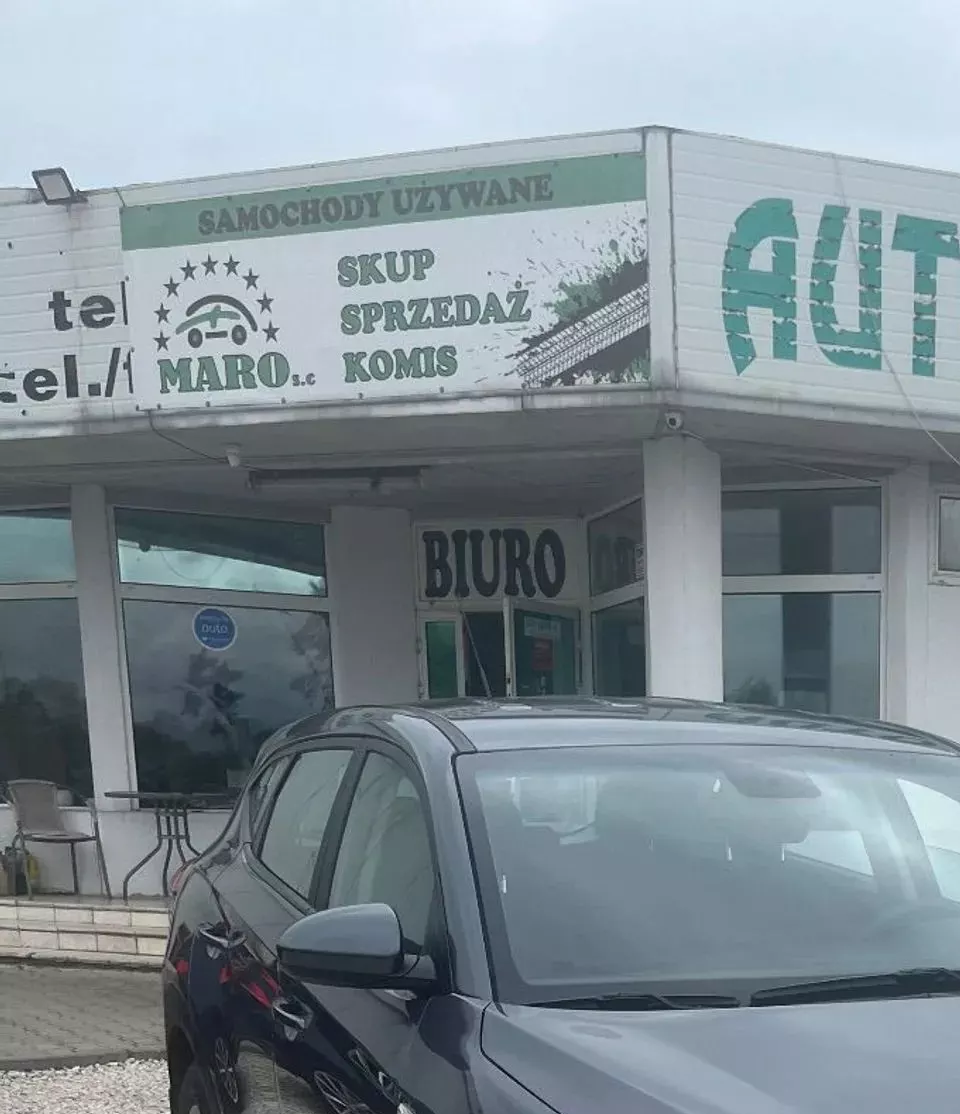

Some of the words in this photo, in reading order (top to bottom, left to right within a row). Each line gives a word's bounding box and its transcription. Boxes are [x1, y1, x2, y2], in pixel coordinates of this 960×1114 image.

[198, 190, 385, 236] SAMOCHODY
[337, 248, 435, 287] SKUP
[340, 280, 532, 335] SPRZEDAŻ
[157, 352, 290, 394] MARO
[342, 345, 458, 383] KOMIS
[422, 528, 566, 598] BIURO
